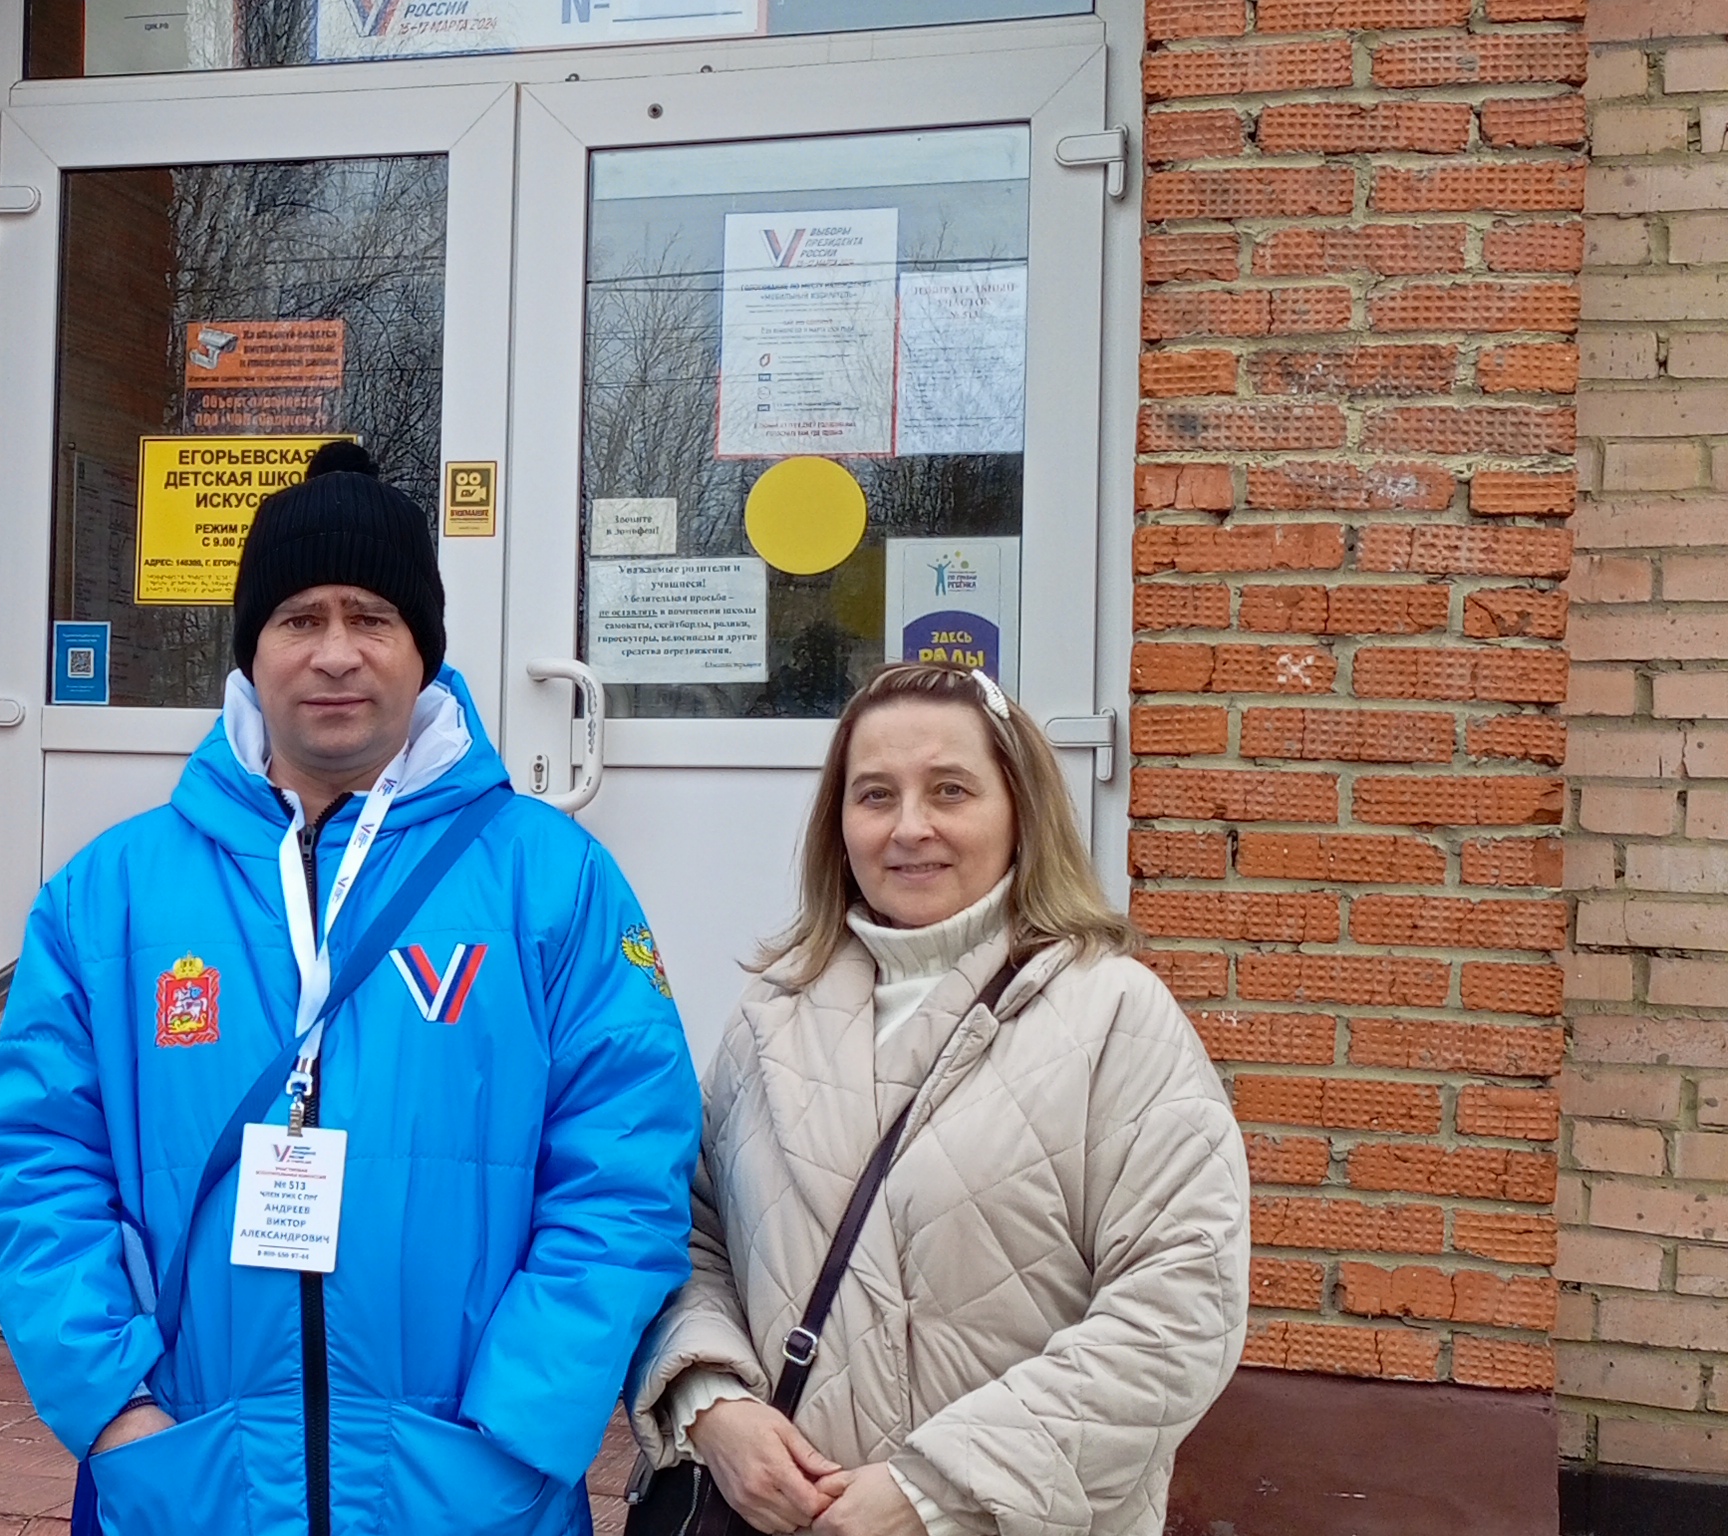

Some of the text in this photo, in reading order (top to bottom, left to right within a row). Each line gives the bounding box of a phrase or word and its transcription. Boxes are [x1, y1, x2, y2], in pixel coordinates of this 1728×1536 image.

[403, 0, 469, 20] РОССИИ
[430, 18, 470, 33] МАРТА
[471, 16, 498, 30] 2024
[810, 227, 852, 237] ВЫБОРЫ
[805, 237, 864, 248] ПРЕЗИДЕНТА
[800, 248, 839, 259] РОССИИ
[178, 449, 316, 465] ЕГОРЬЕВСКАЯ
[164, 471, 252, 489] ДЕТСКАЯ
[195, 524, 238, 534] РЕЖИМ
[202, 537, 210, 547] С
[213, 537, 235, 547] 9.00
[144, 559, 174, 568] АДРЕС:
[618, 565, 679, 574] Уважаемые
[682, 565, 731, 575] родители
[650, 579, 706, 591] учащиеся!
[690, 593, 727, 604] просьба
[722, 607, 756, 615] школы
[605, 622, 652, 630] самокаты,
[713, 621, 751, 630] ролики,
[725, 634, 758, 643] другие
[930, 631, 973, 643] ЗДЕСЬ
[621, 647, 661, 657] средства
[289, 1180, 306, 1191] 513
[264, 1203, 310, 1215] АНДРЕЕВ
[266, 1217, 307, 1228] ВИКТОР
[239, 1228, 330, 1244] АЛЕКСАНДРОВИЧ
